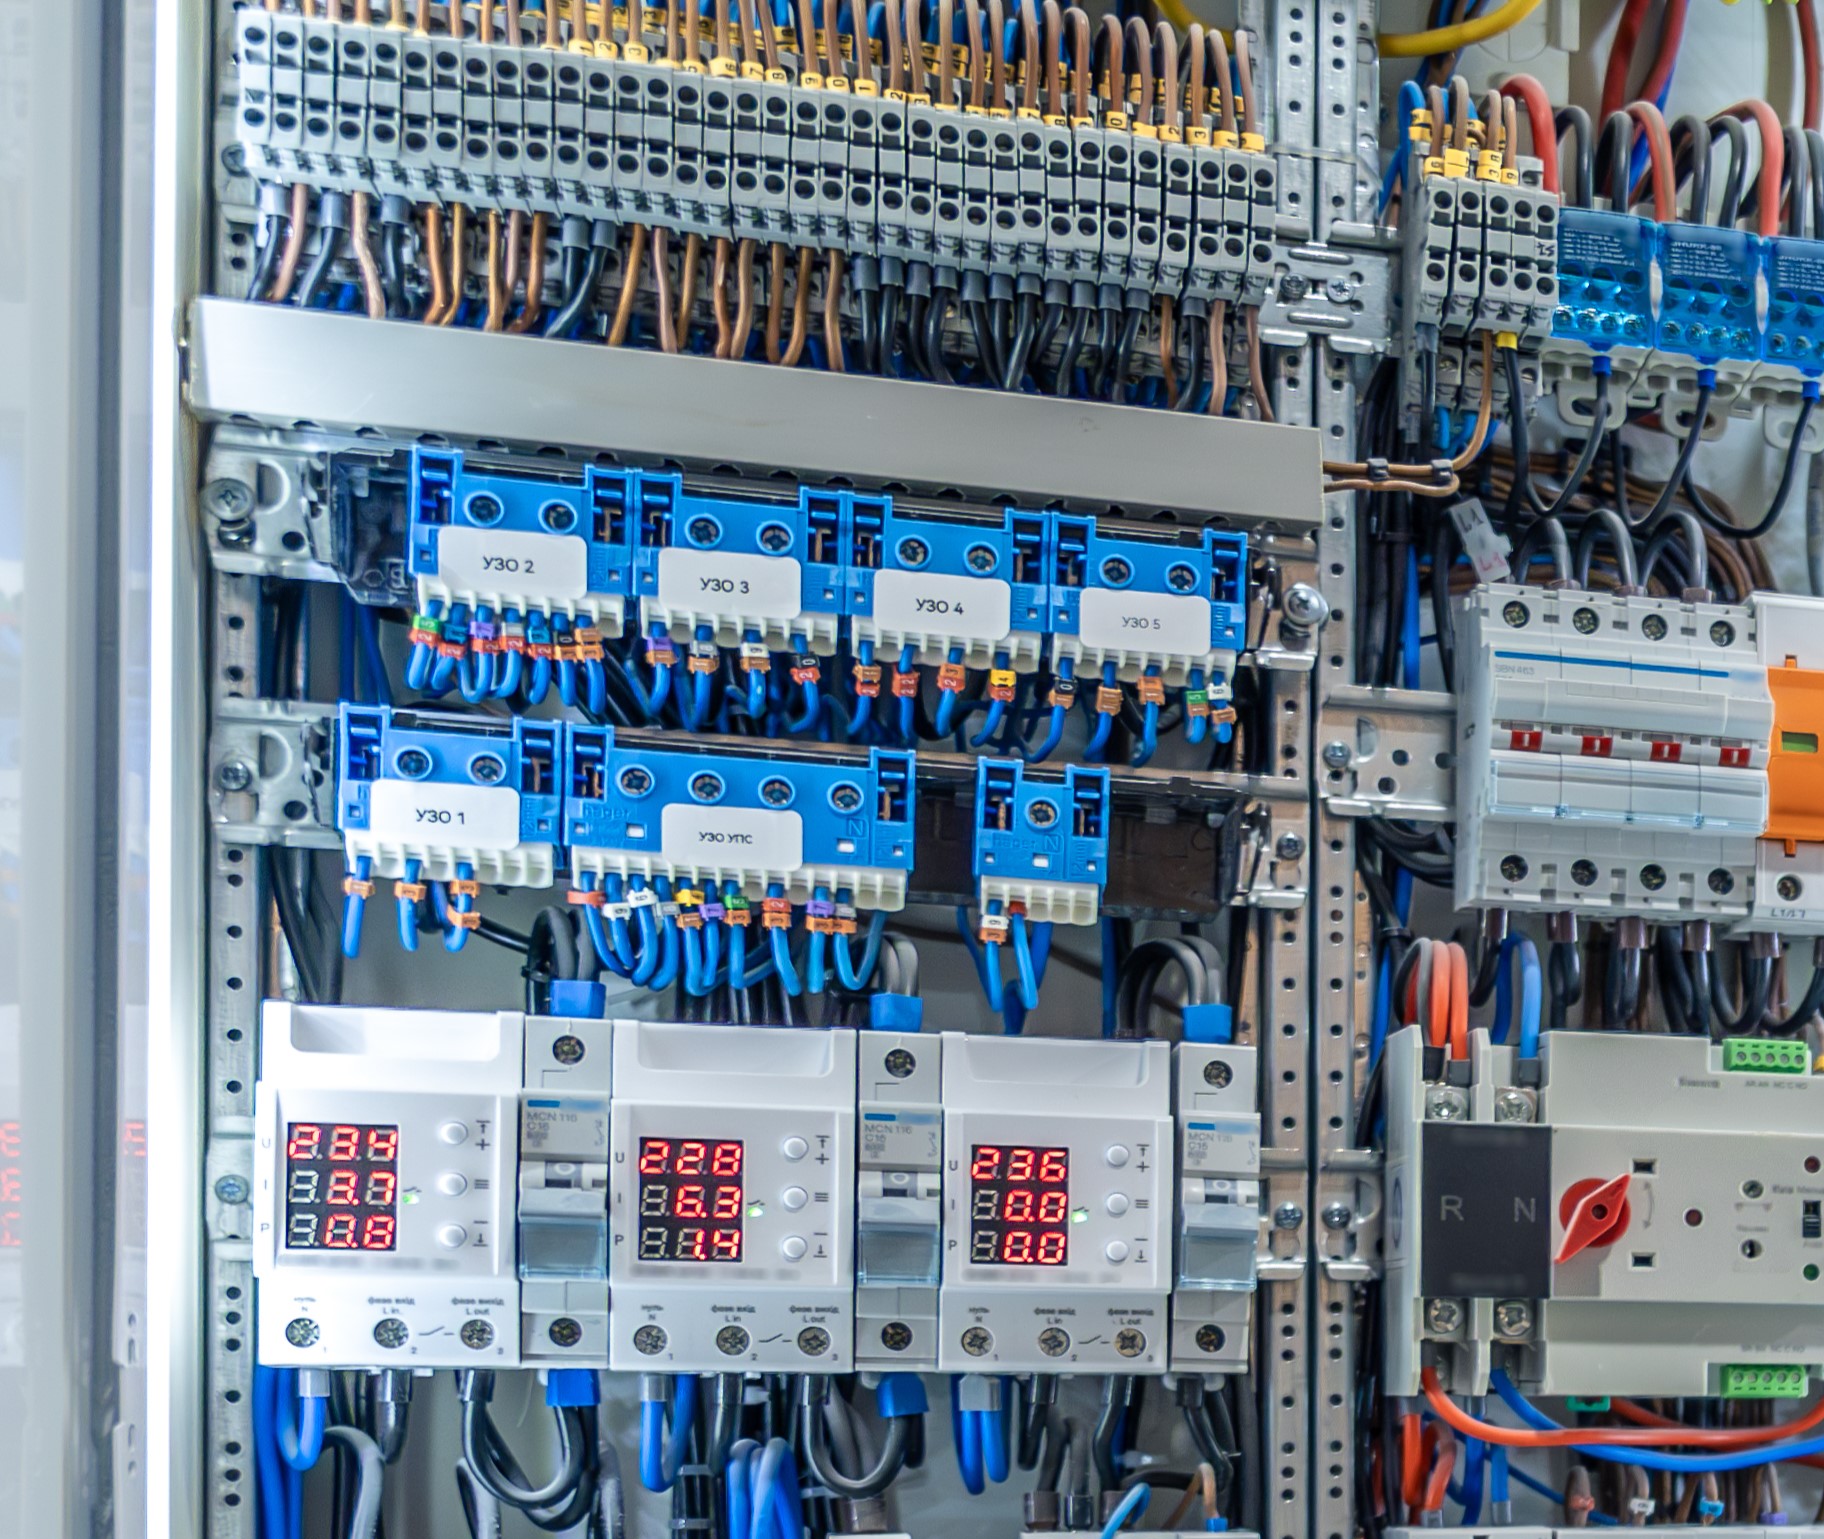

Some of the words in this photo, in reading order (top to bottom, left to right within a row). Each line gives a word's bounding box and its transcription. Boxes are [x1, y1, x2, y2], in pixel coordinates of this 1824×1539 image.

[482, 555, 519, 572] УЗО
[524, 560, 535, 574] 2
[700, 577, 734, 593] УЗО
[740, 580, 750, 594] 3
[915, 598, 949, 613] УЗО
[953, 602, 964, 615] 4
[1121, 615, 1149, 629] УЗО
[1152, 619, 1161, 630] 5
[416, 809, 451, 824] УЗО
[457, 811, 465, 825] 1
[698, 831, 724, 843] УЗО
[728, 834, 753, 844] УПС
[262, 1138, 271, 1149] U
[288, 1124, 398, 1161] 234
[615, 1152, 624, 1164] U
[639, 1141, 741, 1176] 228
[949, 1161, 958, 1171] U
[972, 1147, 1067, 1182] 236
[327, 1169, 396, 1206] 3.7
[675, 1185, 741, 1219] 6.3
[1004, 1190, 1067, 1223] 0.0
[1440, 1195, 1464, 1221] R
[1514, 1196, 1536, 1223] N
[261, 1223, 269, 1232] P
[324, 1213, 396, 1250] 0.8
[615, 1235, 624, 1246] P
[693, 1229, 741, 1261] 1.4
[949, 1240, 958, 1250] P
[1004, 1230, 1067, 1263] 0.0
